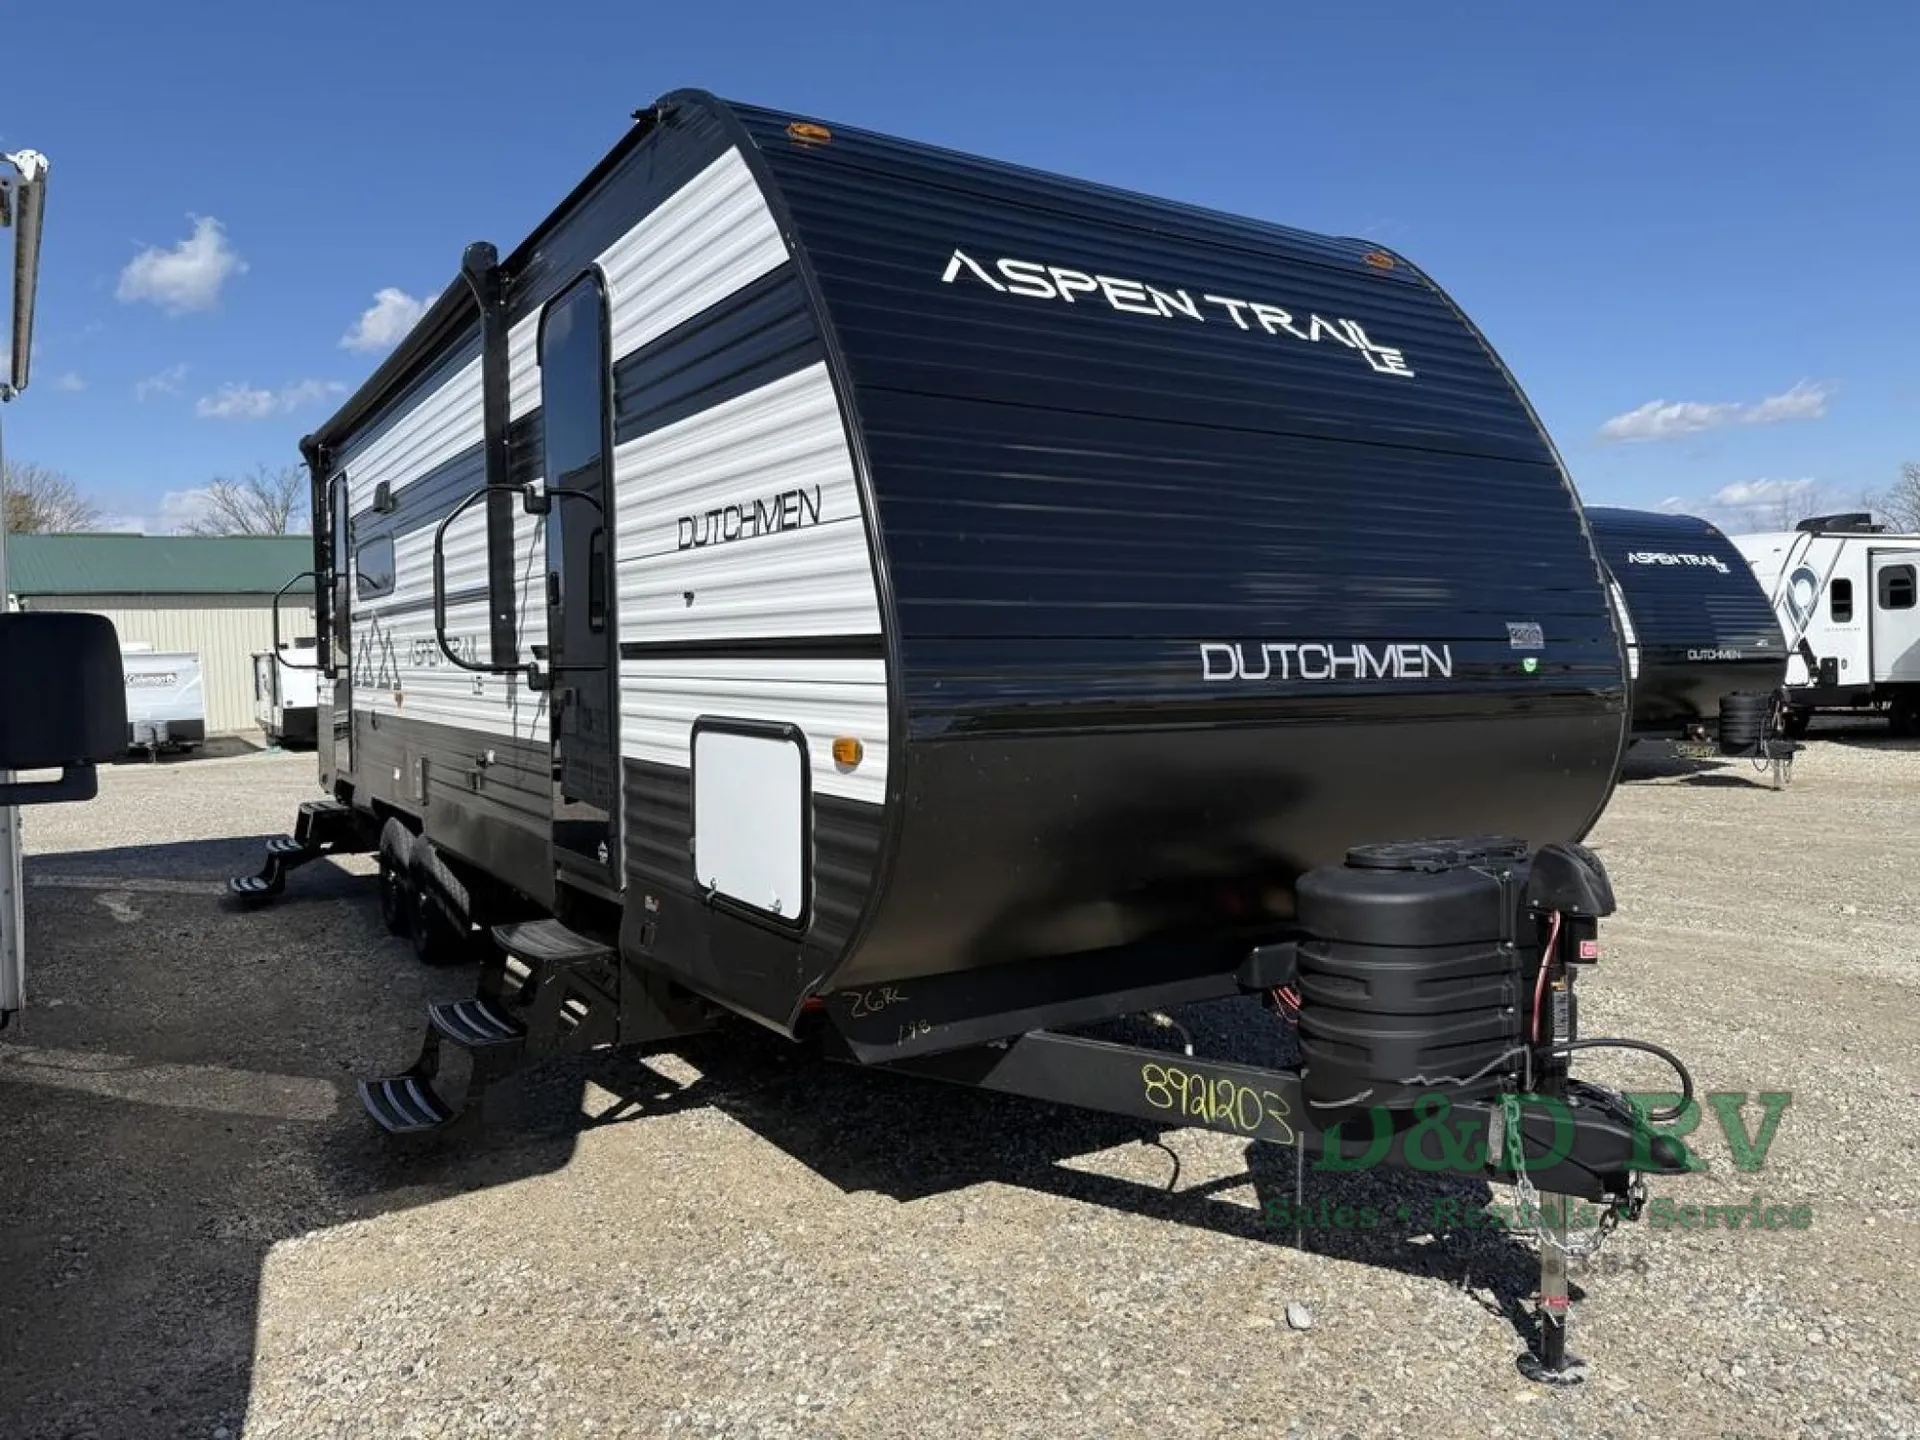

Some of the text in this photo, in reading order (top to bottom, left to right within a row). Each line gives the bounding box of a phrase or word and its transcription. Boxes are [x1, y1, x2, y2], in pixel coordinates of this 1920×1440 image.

[942, 249, 1402, 351] ASPEN TRAIL
[1362, 349, 1414, 378] LE
[677, 486, 822, 551] DUTCHMEN
[1201, 643, 1453, 680] DUTCHMEN
[1142, 1063, 1295, 1145] 8921203
